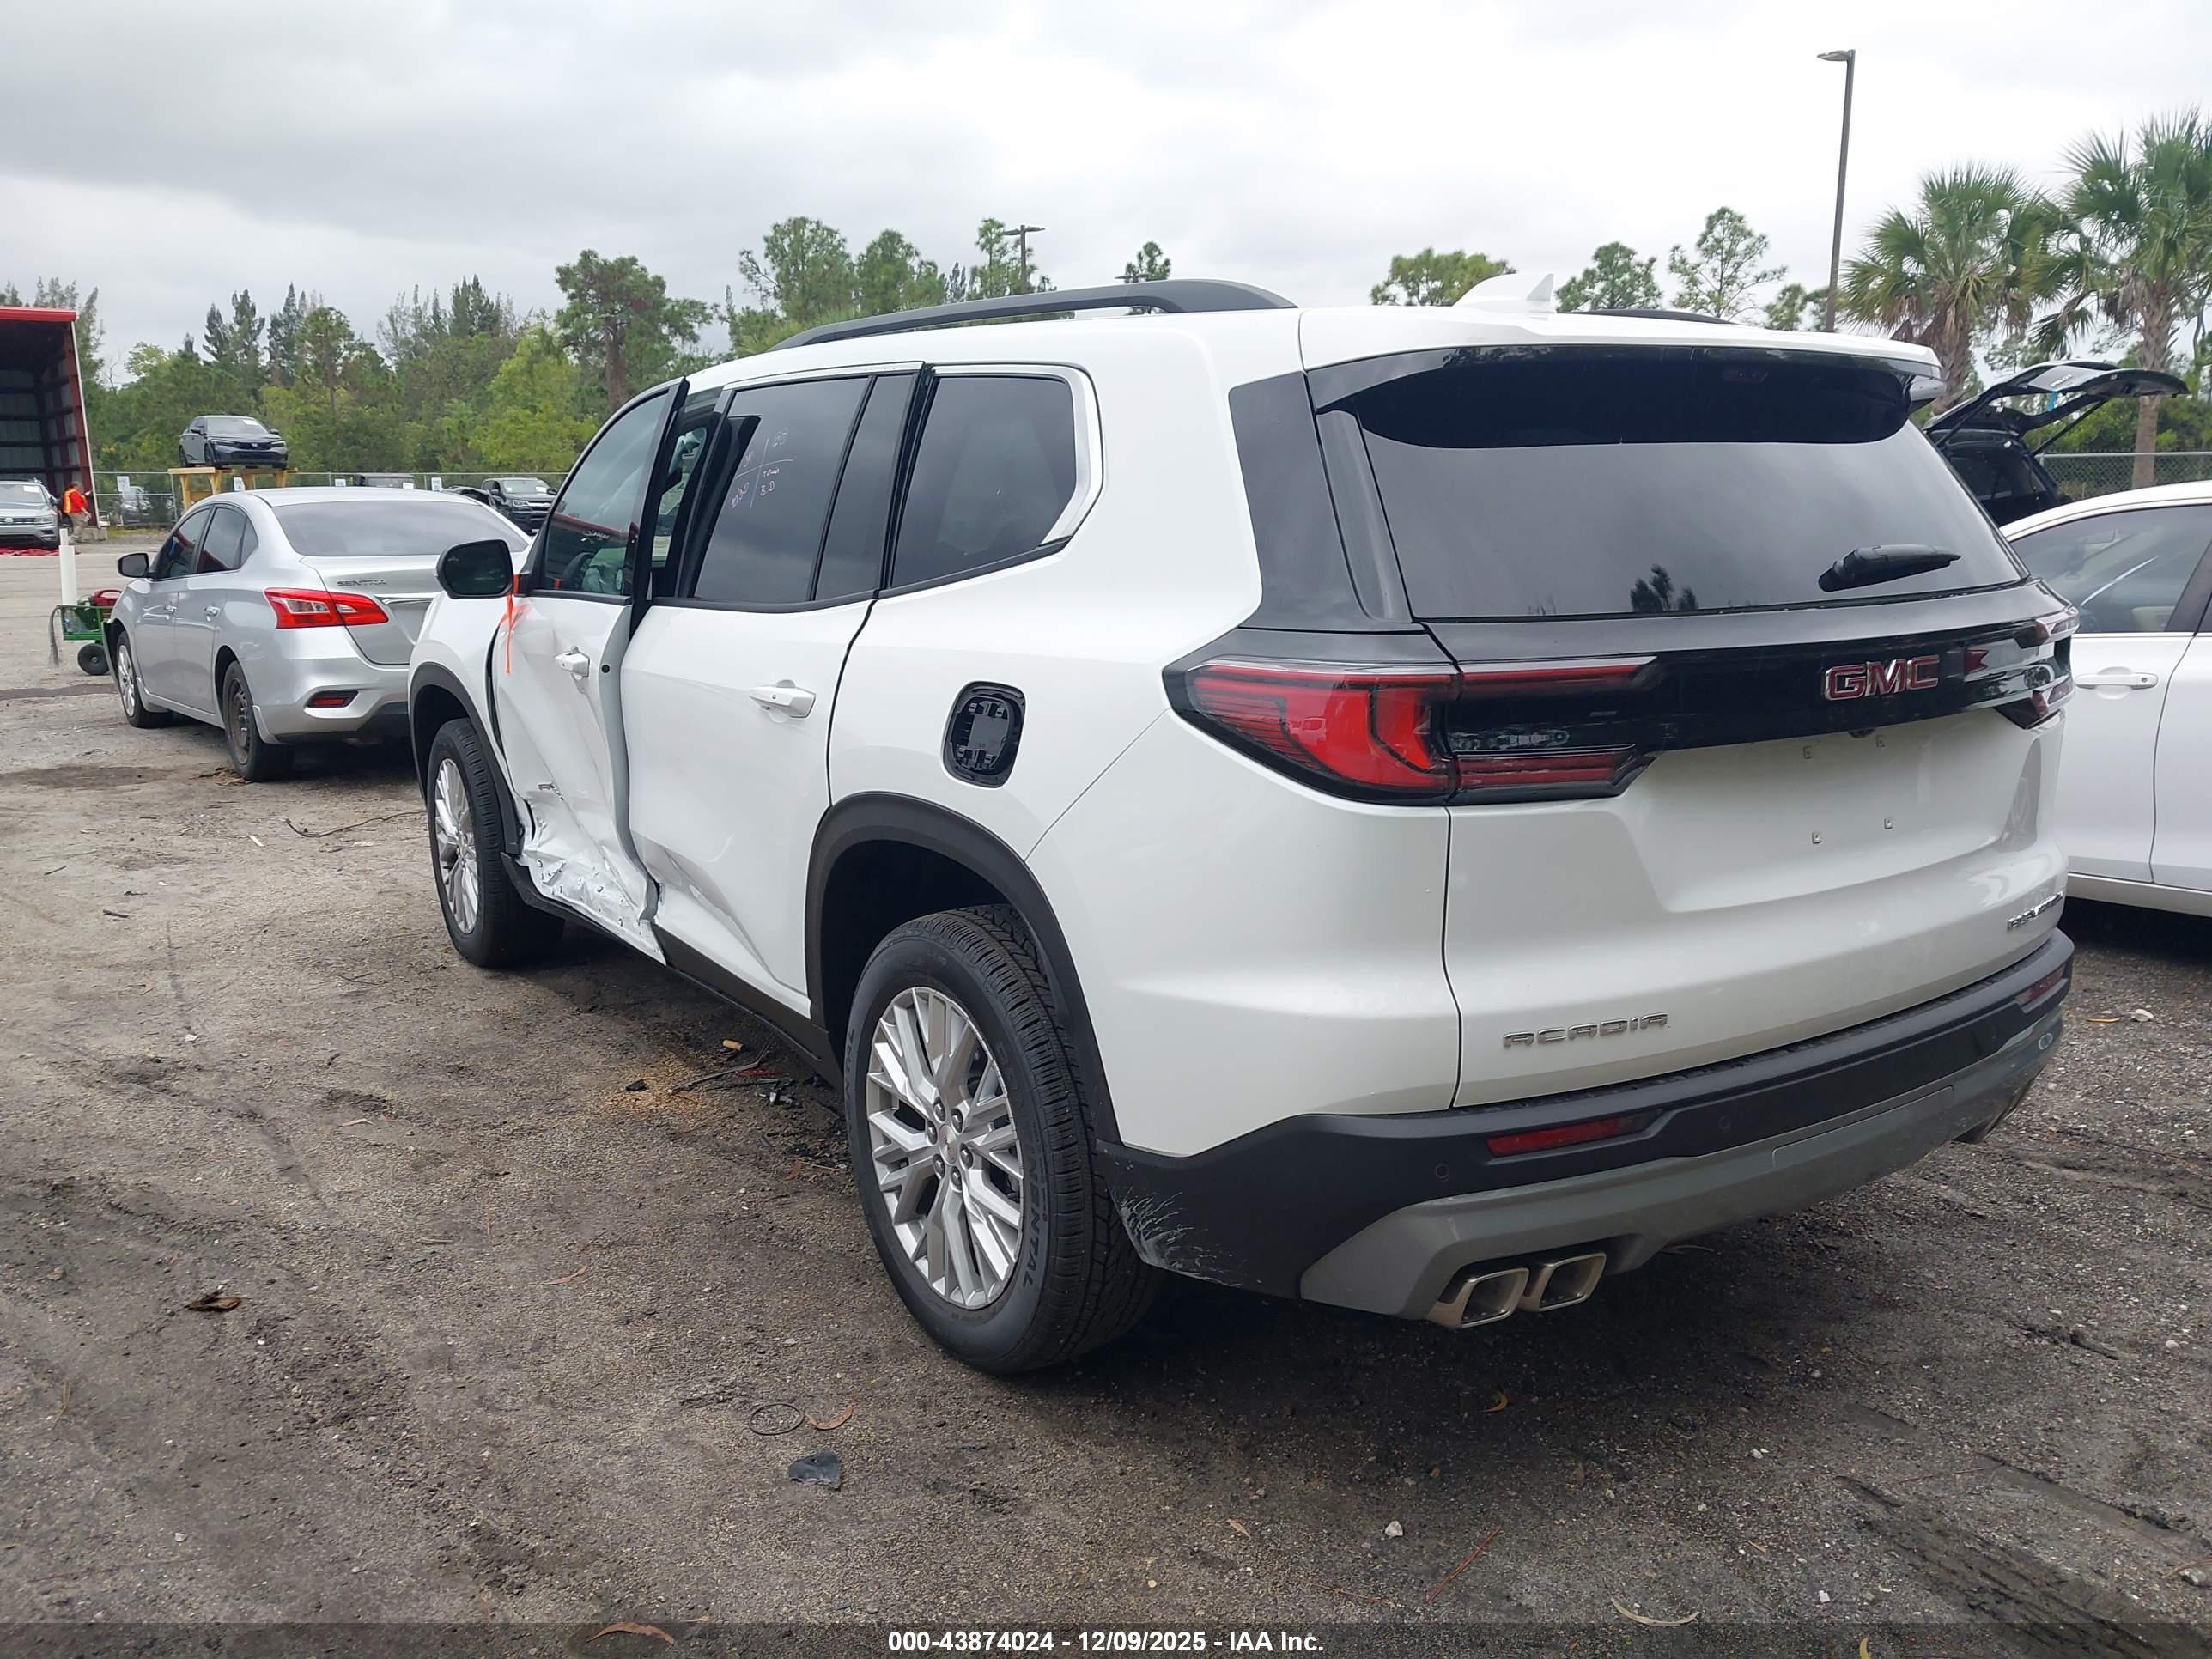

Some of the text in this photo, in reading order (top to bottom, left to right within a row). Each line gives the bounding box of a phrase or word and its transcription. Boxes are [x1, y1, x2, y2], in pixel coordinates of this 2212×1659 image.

[337, 578, 387, 586] SENTRA
[1824, 653, 1940, 701] GMC
[1504, 1012, 1668, 1048] ACADIA
